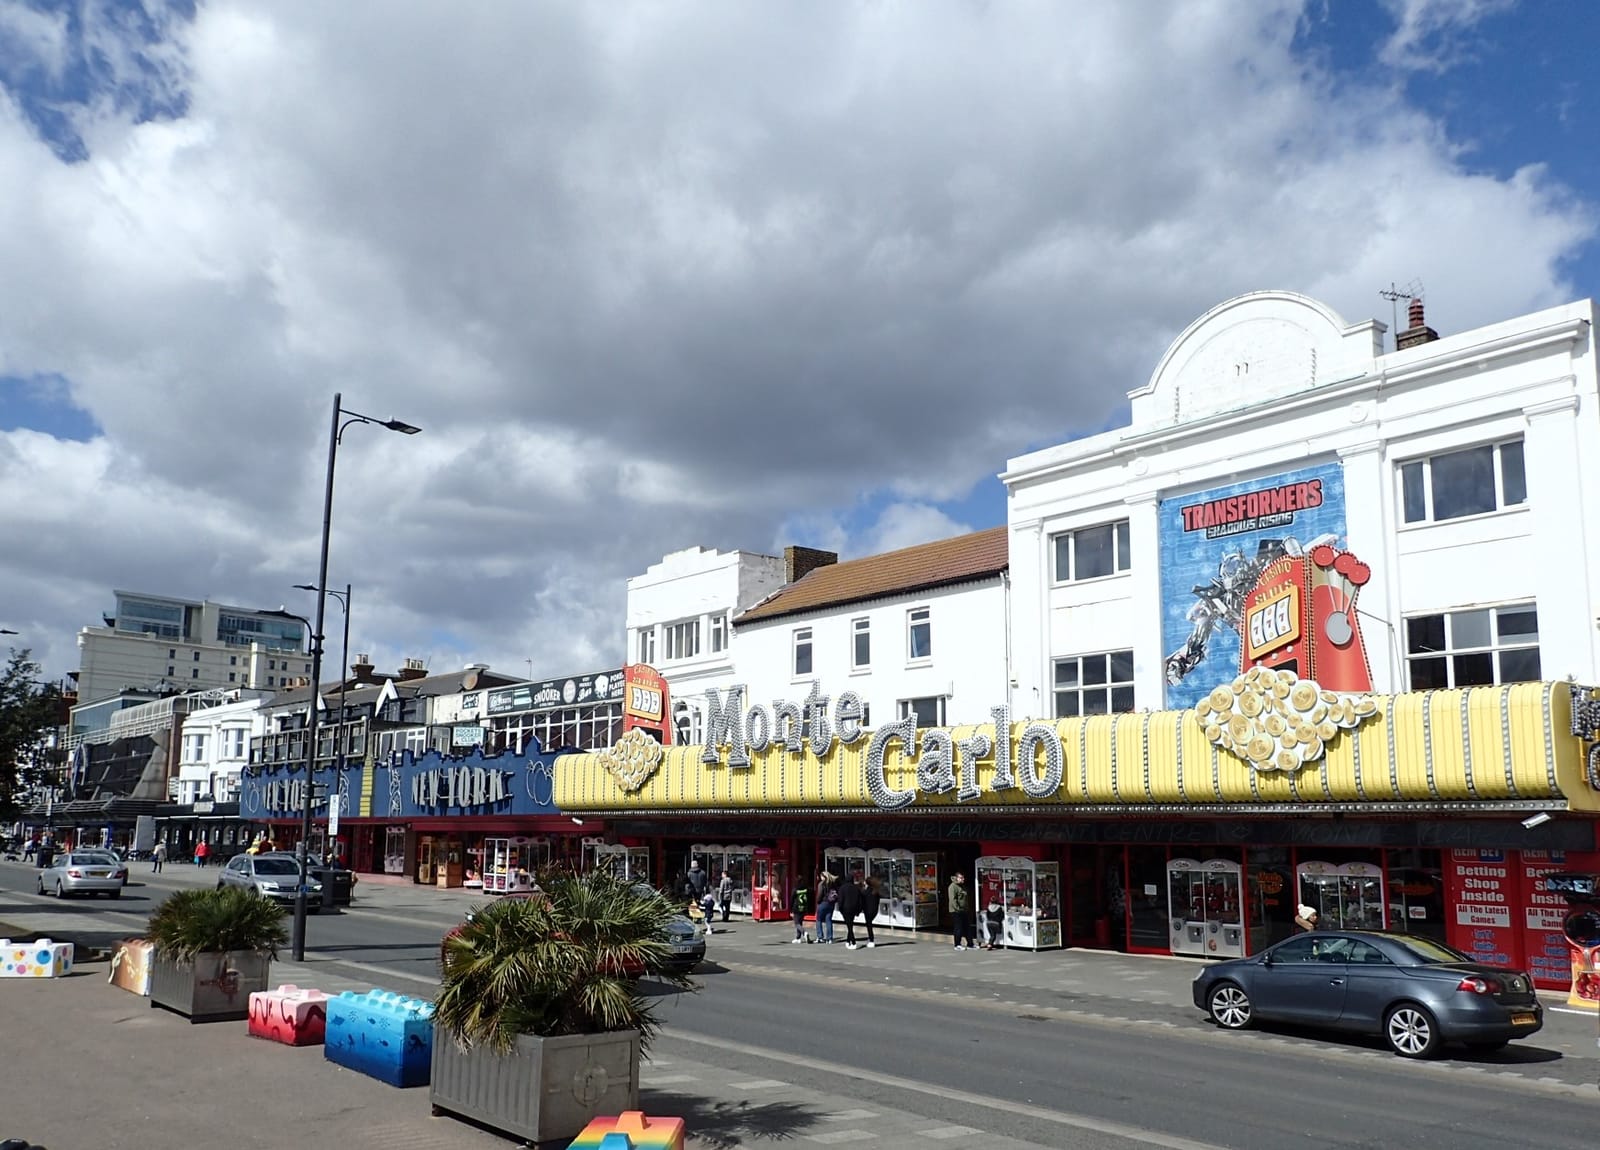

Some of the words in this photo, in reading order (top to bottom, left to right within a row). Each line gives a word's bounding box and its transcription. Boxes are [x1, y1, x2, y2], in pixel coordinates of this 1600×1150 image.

[1182, 479, 1322, 532] TRANSFORMERS
[1207, 518, 1257, 538] SHADOWS
[1258, 512, 1293, 529] RISING
[1260, 560, 1292, 586] CASINO
[533, 688, 561, 705] SNOOKER
[701, 678, 865, 769] Monte
[866, 703, 1064, 811] Carlo
[412, 768, 440, 808] NEW
[448, 765, 504, 808] YORK
[853, 822, 935, 839] PREMIER
[947, 821, 1090, 841] AMUSEMENT
[1104, 823, 1202, 842] CENTRE
[1456, 865, 1506, 878] Betting
[1464, 878, 1500, 890] Shop
[1461, 891, 1505, 902] Inside
[1458, 905, 1468, 913] All
[1469, 905, 1483, 914] The
[1484, 906, 1508, 915] Latest
[1470, 915, 1496, 924] Games
[1527, 908, 1538, 916] All
[1540, 909, 1554, 917] The
